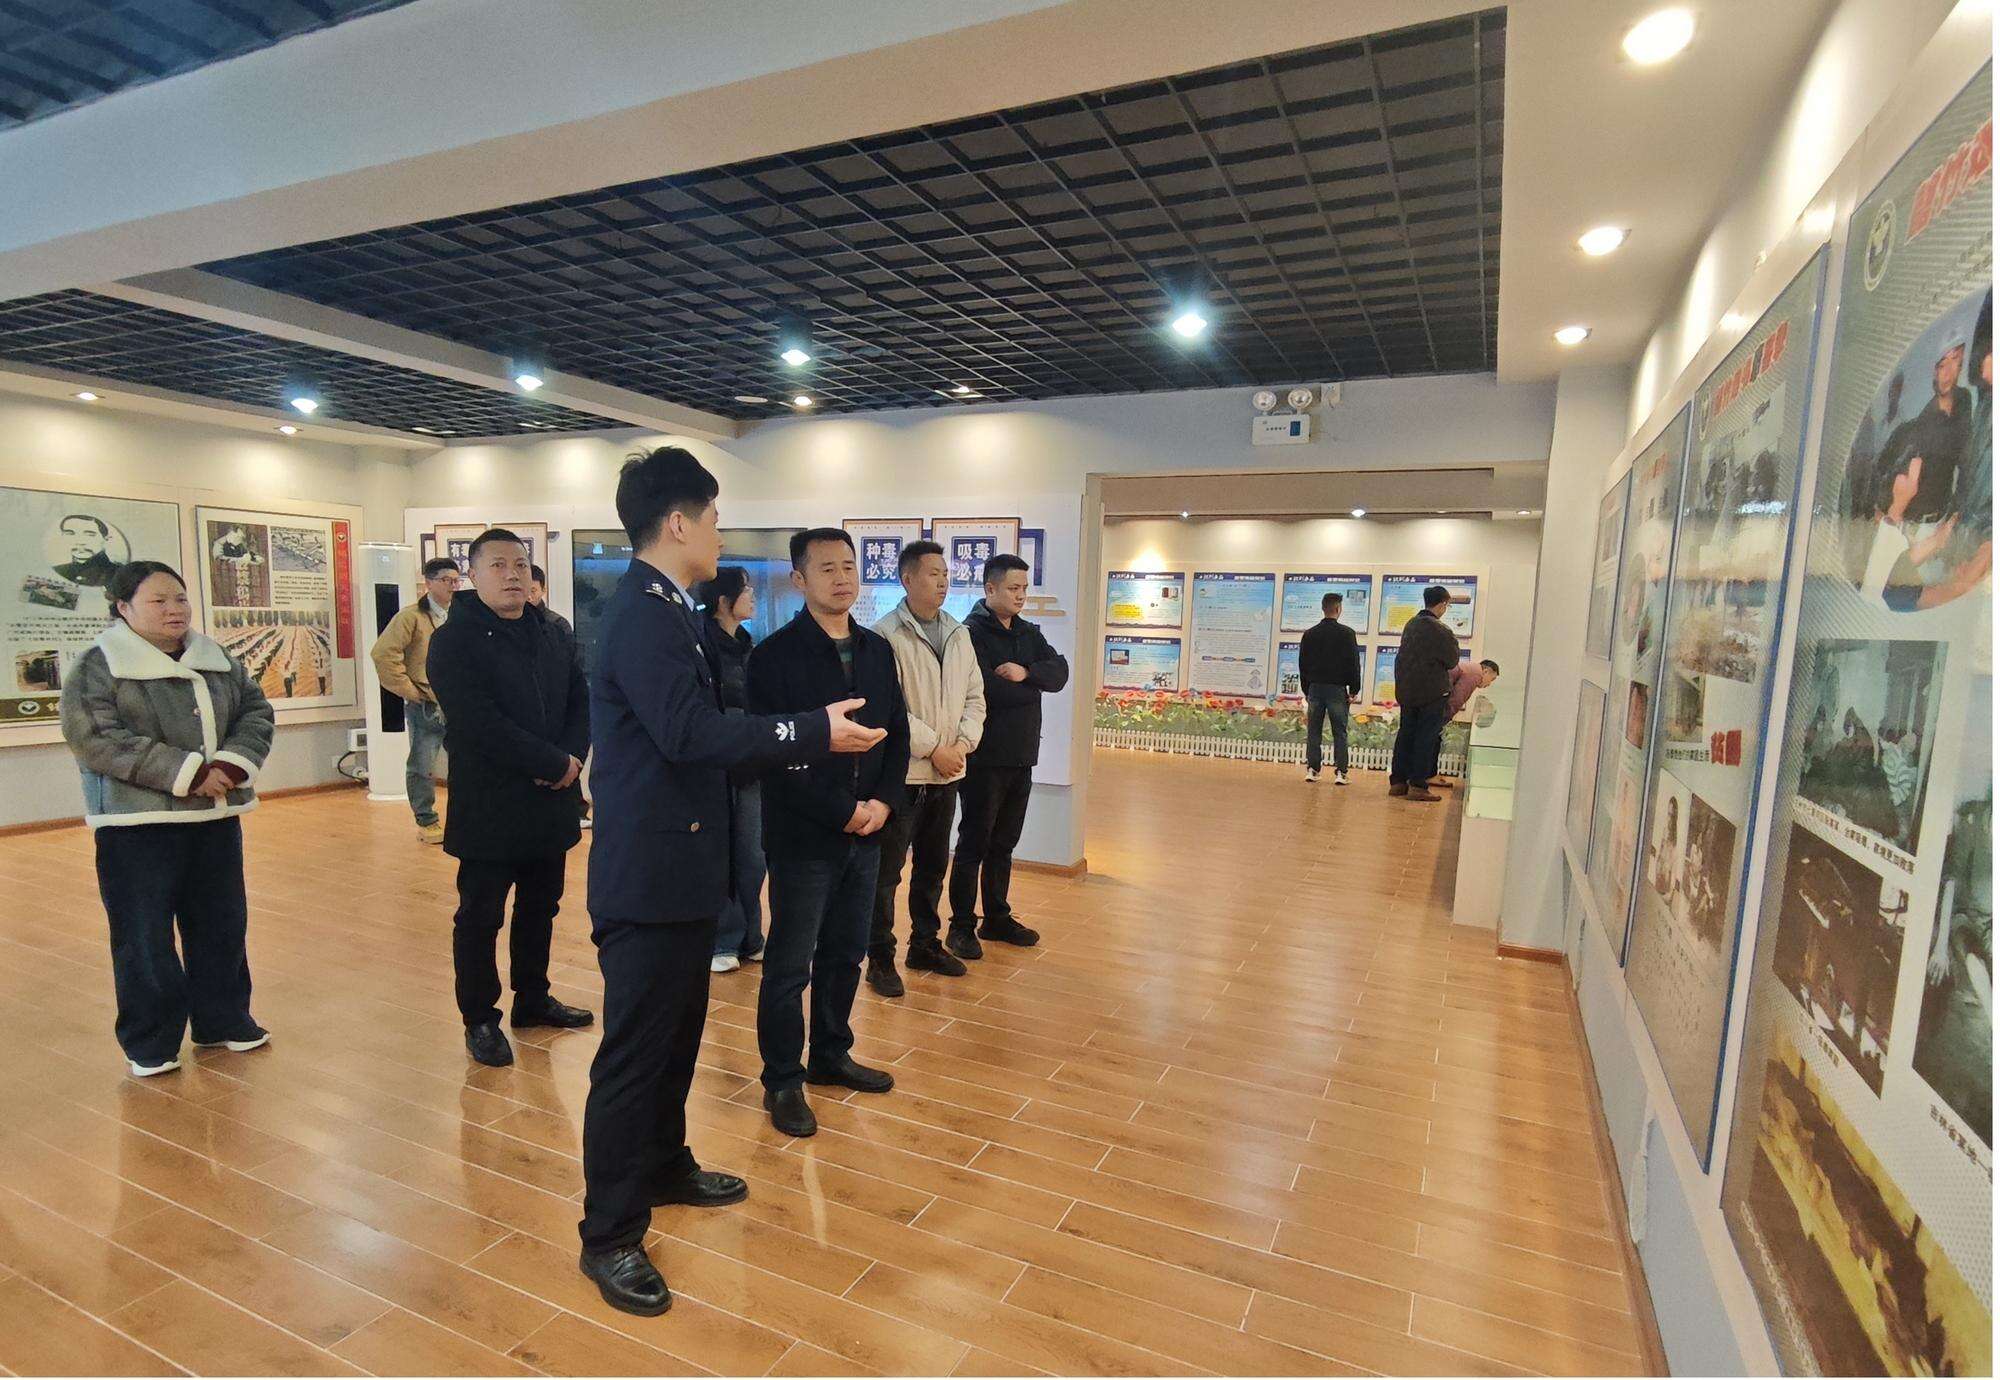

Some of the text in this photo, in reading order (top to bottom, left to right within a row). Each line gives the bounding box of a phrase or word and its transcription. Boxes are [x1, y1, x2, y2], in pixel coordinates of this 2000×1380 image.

[866, 542, 897, 560] 种毒
[957, 543, 990, 560] 吸毒
[866, 562, 897, 579] 必究
